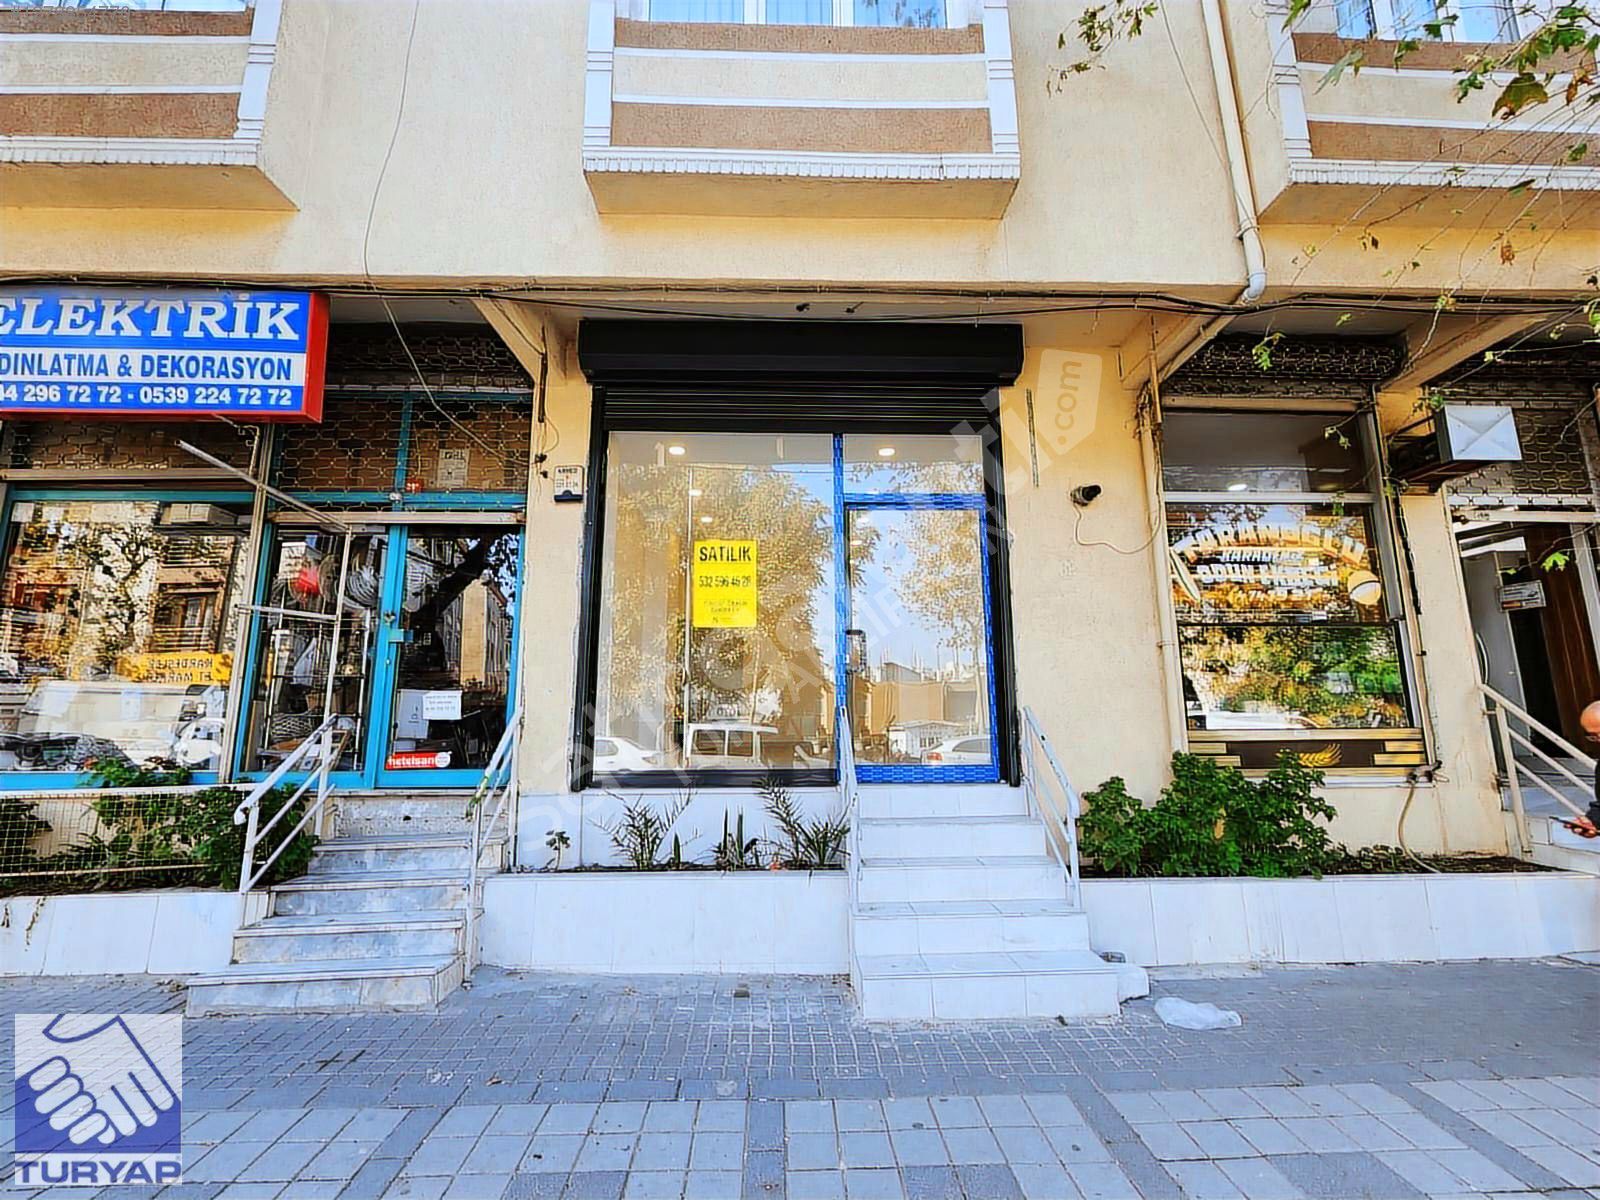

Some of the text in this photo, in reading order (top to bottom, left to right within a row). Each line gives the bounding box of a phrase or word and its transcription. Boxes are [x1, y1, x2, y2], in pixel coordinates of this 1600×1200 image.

[117, 354, 132, 377] &
[140, 354, 292, 381] DEKORASYON
[0, 384, 18, 402] 4
[23, 384, 61, 403] 296
[66, 385, 92, 403] 72
[97, 385, 122, 403] 72
[139, 386, 189, 405] 0539
[195, 387, 232, 405] 224
[237, 388, 262, 406] 72
[268, 388, 293, 407] 72
